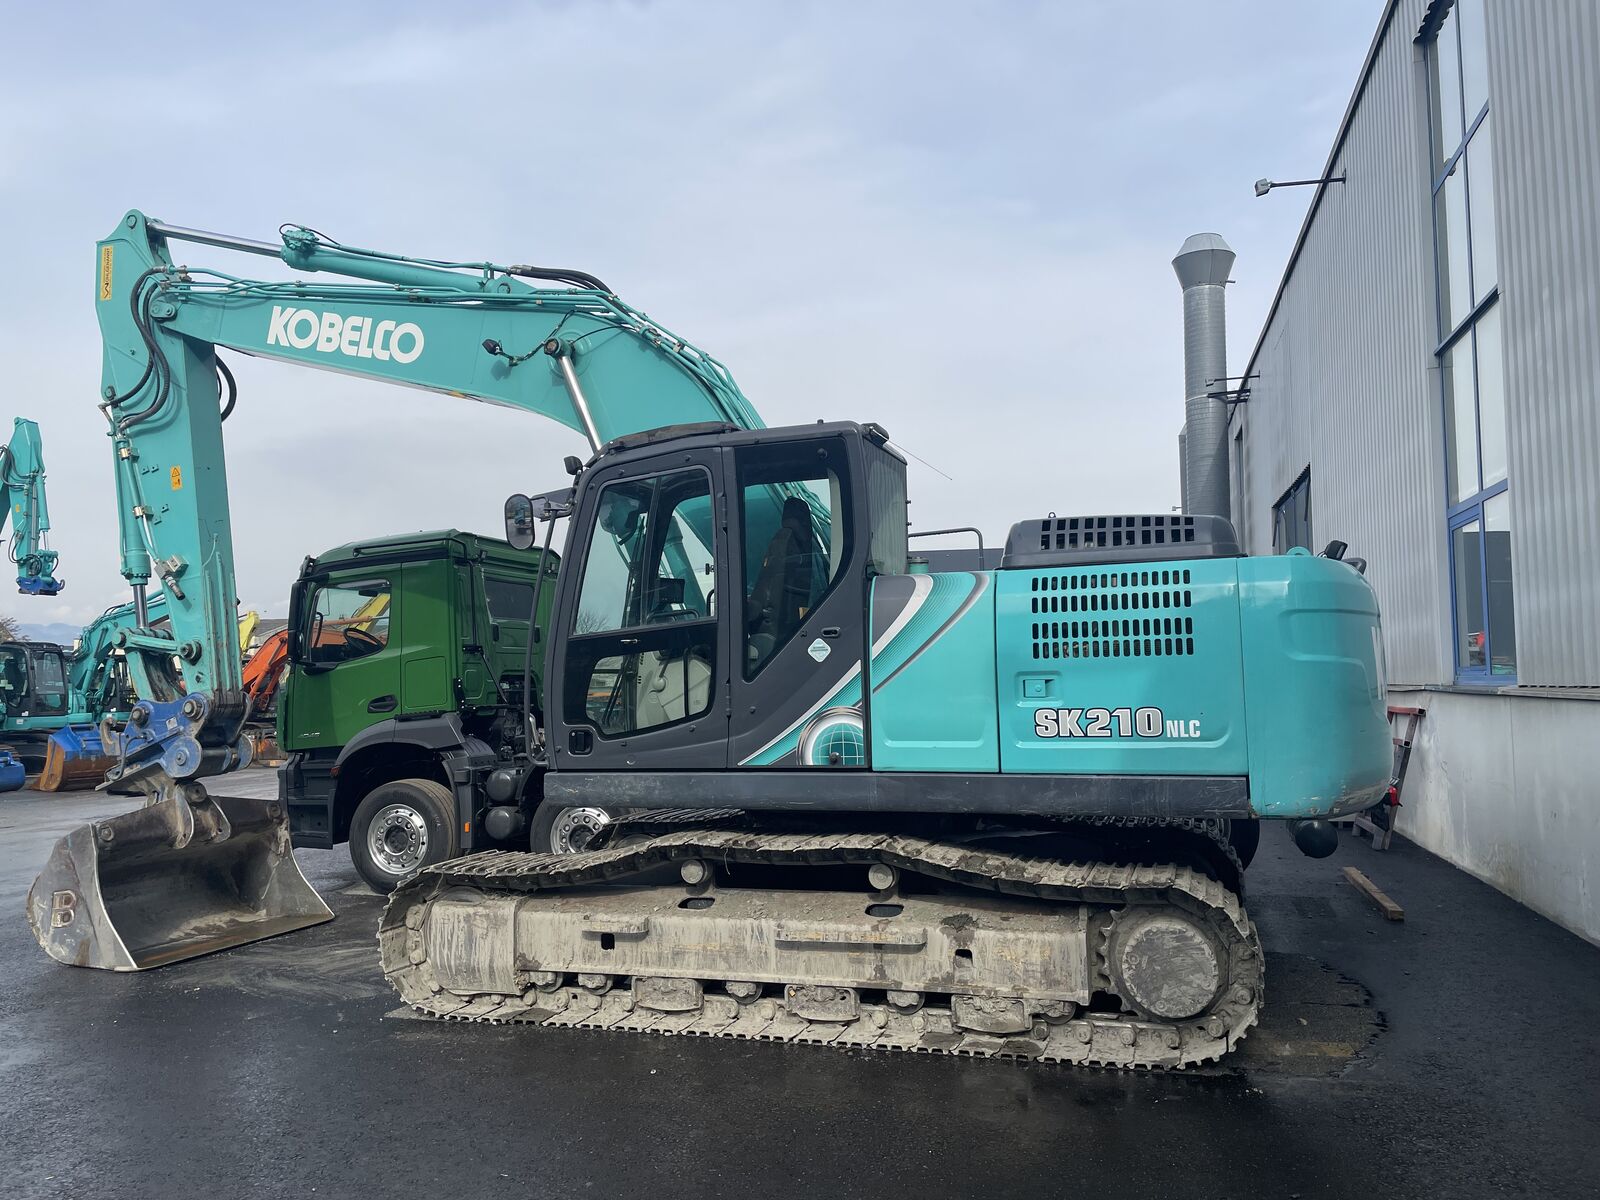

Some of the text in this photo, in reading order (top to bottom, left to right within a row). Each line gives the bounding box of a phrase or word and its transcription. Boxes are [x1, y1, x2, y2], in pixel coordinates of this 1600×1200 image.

[266, 305, 425, 364] KOBELCO
[1034, 707, 1201, 738] SK210 NLC
